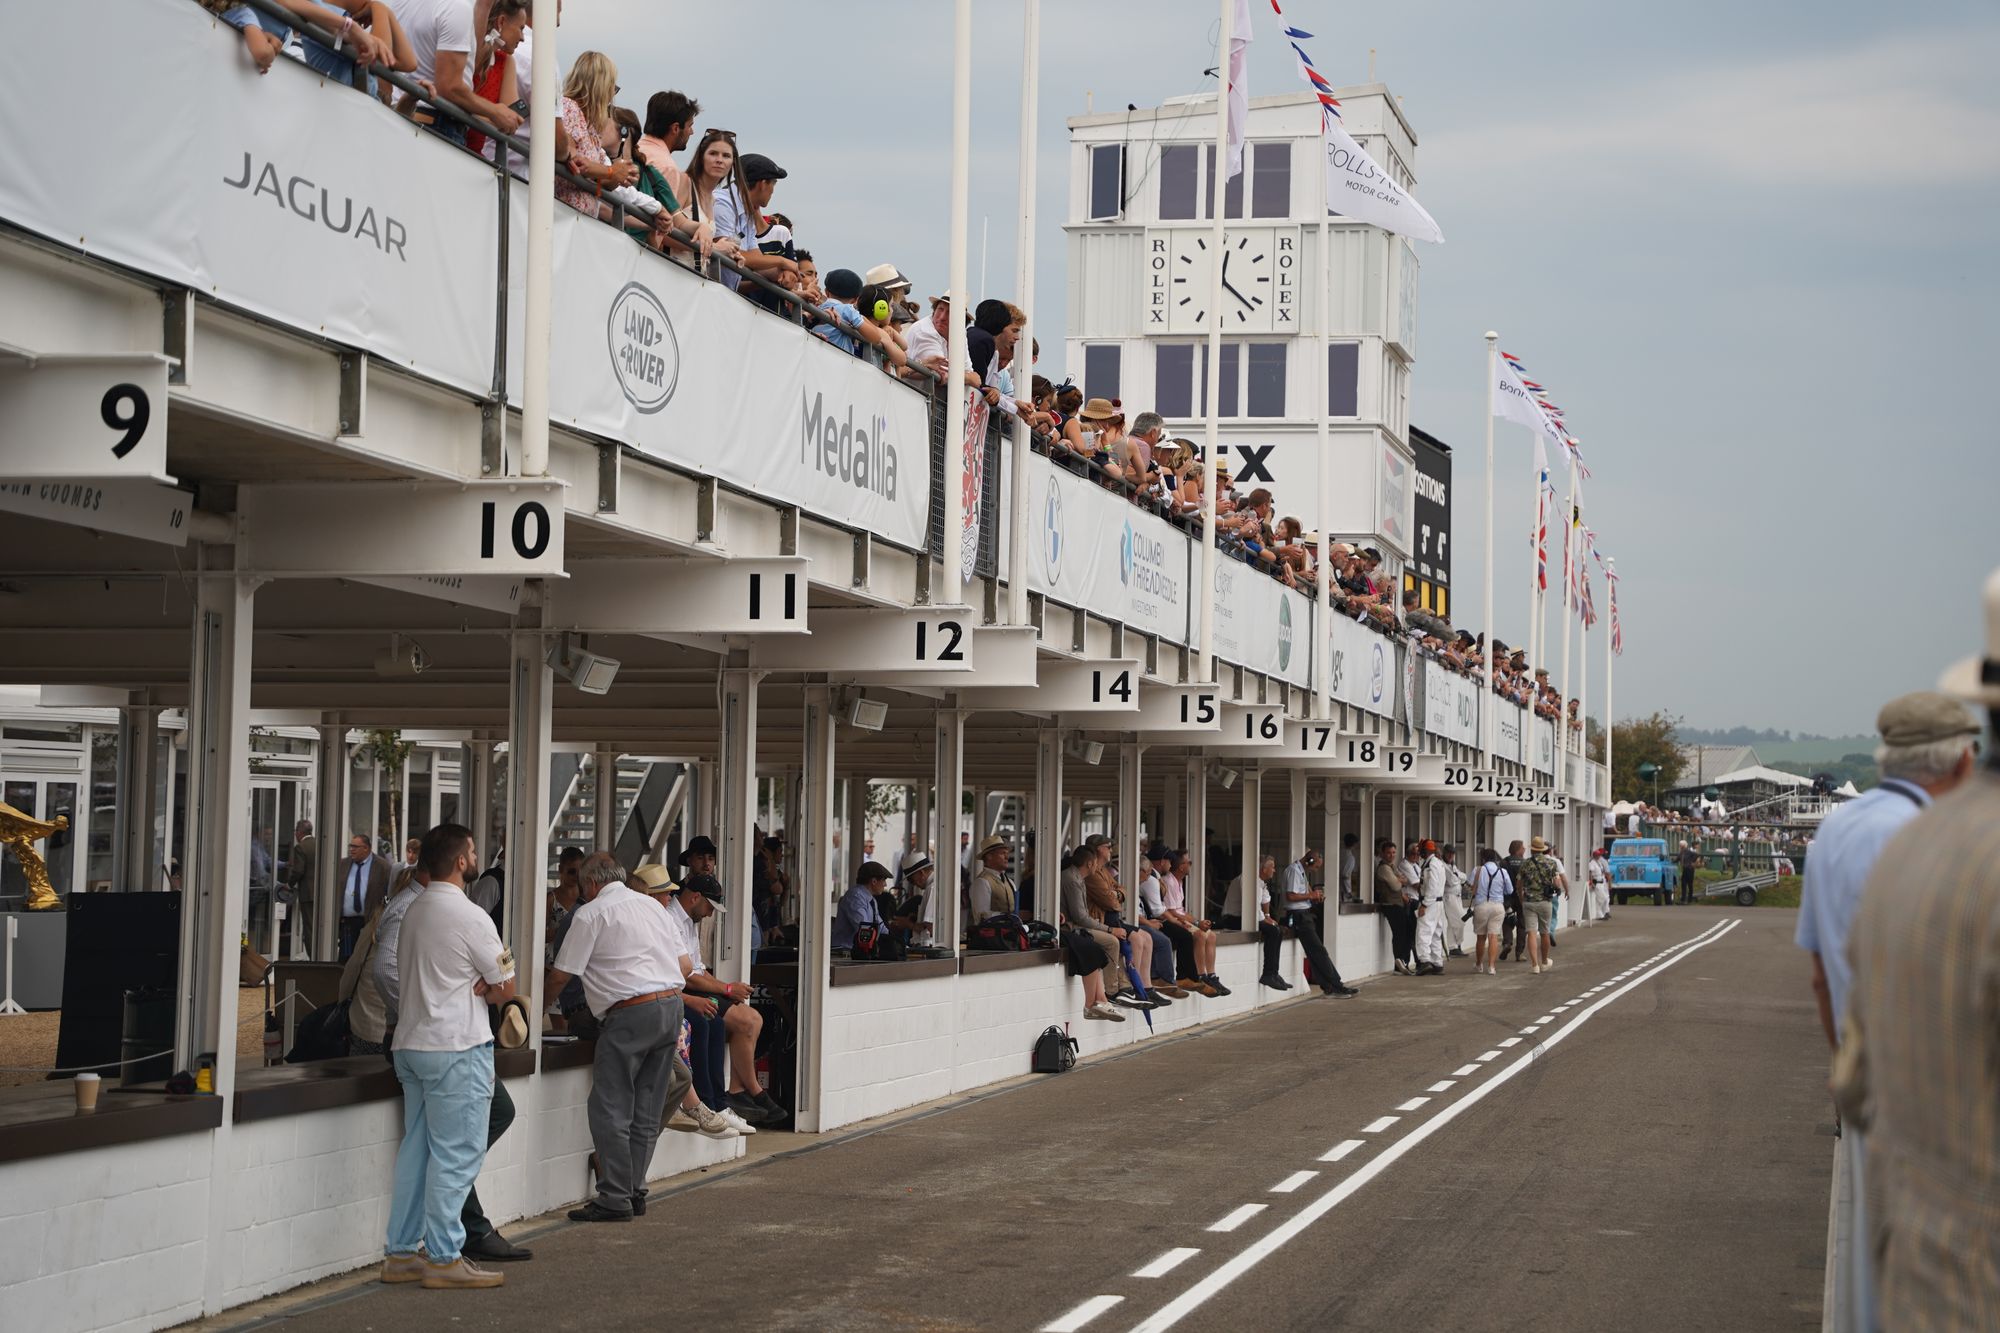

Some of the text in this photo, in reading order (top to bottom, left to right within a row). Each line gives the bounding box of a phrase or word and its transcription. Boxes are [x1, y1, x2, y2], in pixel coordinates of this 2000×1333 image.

[223, 151, 407, 262] JAGUAR
[1345, 180, 1401, 206] MOTOR CARS
[1150, 239, 1166, 323] ROLEX
[1277, 237, 1293, 322] ROLEX
[624, 304, 655, 347] LAND
[625, 343, 665, 388] ROVER
[101, 384, 151, 459] 9
[801, 384, 898, 503] Medallia
[40, 484, 102, 511] COOMBS
[1415, 470, 1446, 507] OSITIONS
[169, 508, 183, 529] 10
[481, 501, 551, 560] 10
[748, 573, 796, 620] 11
[916, 621, 964, 662] 12
[1092, 670, 1132, 704] 14
[1179, 694, 1216, 724] 15
[1246, 713, 1278, 740] 16
[1300, 727, 1331, 752] 17
[1348, 740, 1376, 763] 18
[1388, 751, 1413, 773] 19
[1444, 767, 1469, 786] 20
[1472, 776, 1493, 793] 21
